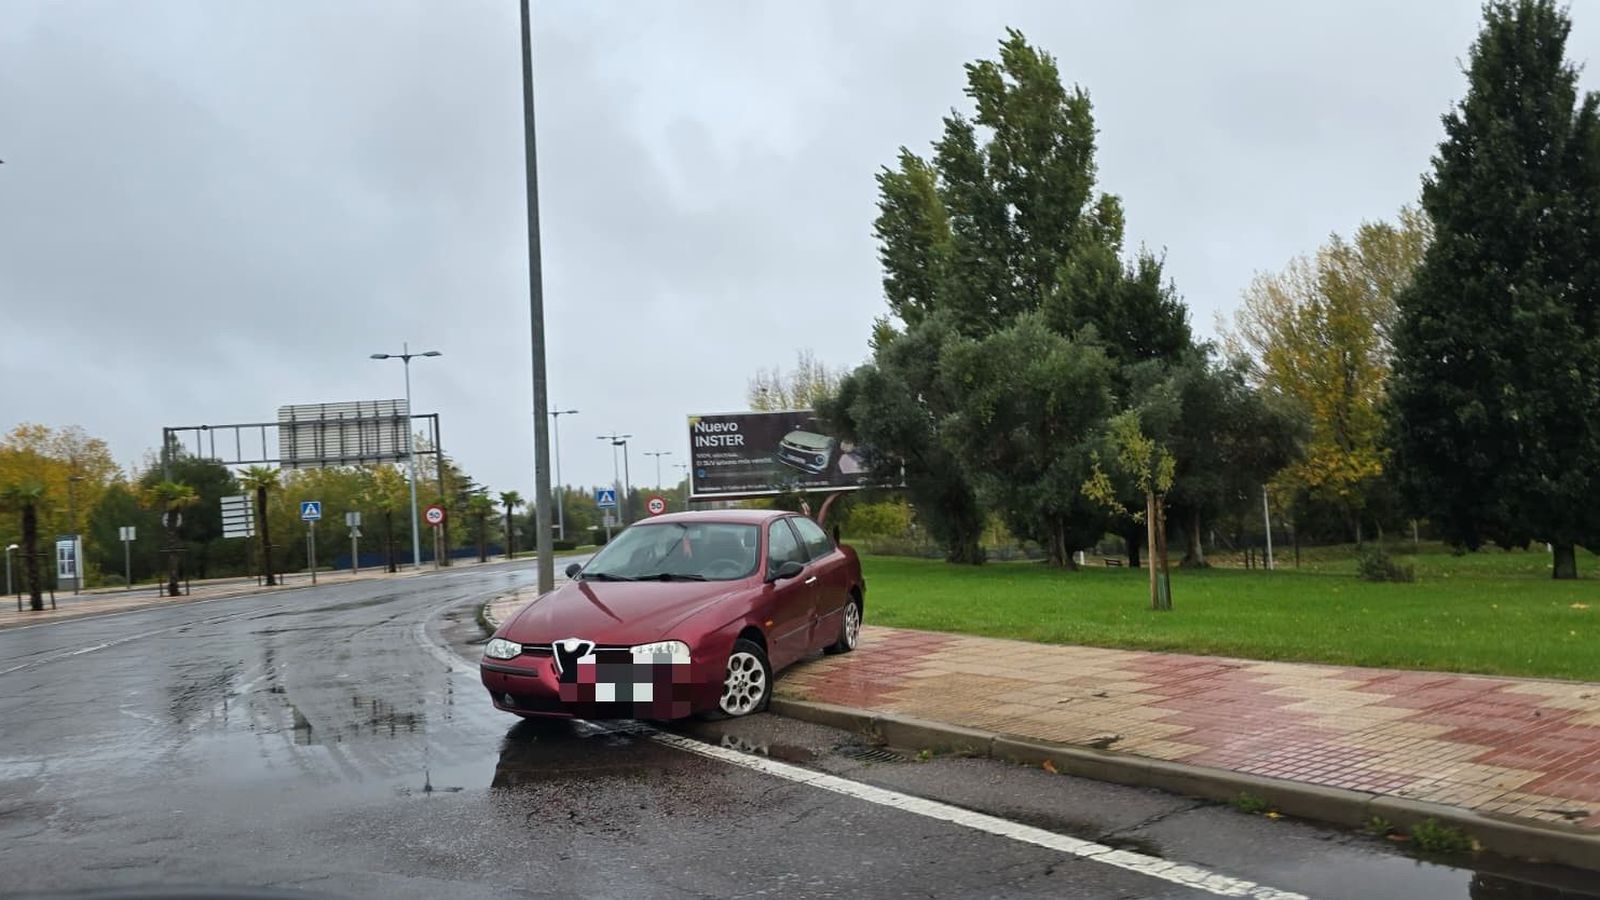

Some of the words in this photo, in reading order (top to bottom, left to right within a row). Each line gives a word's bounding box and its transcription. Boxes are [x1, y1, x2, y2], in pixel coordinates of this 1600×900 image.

[695, 422, 738, 433] Nuevo
[695, 435, 745, 447] INSTER
[650, 502, 662, 510] 50
[429, 511, 441, 519] 50
